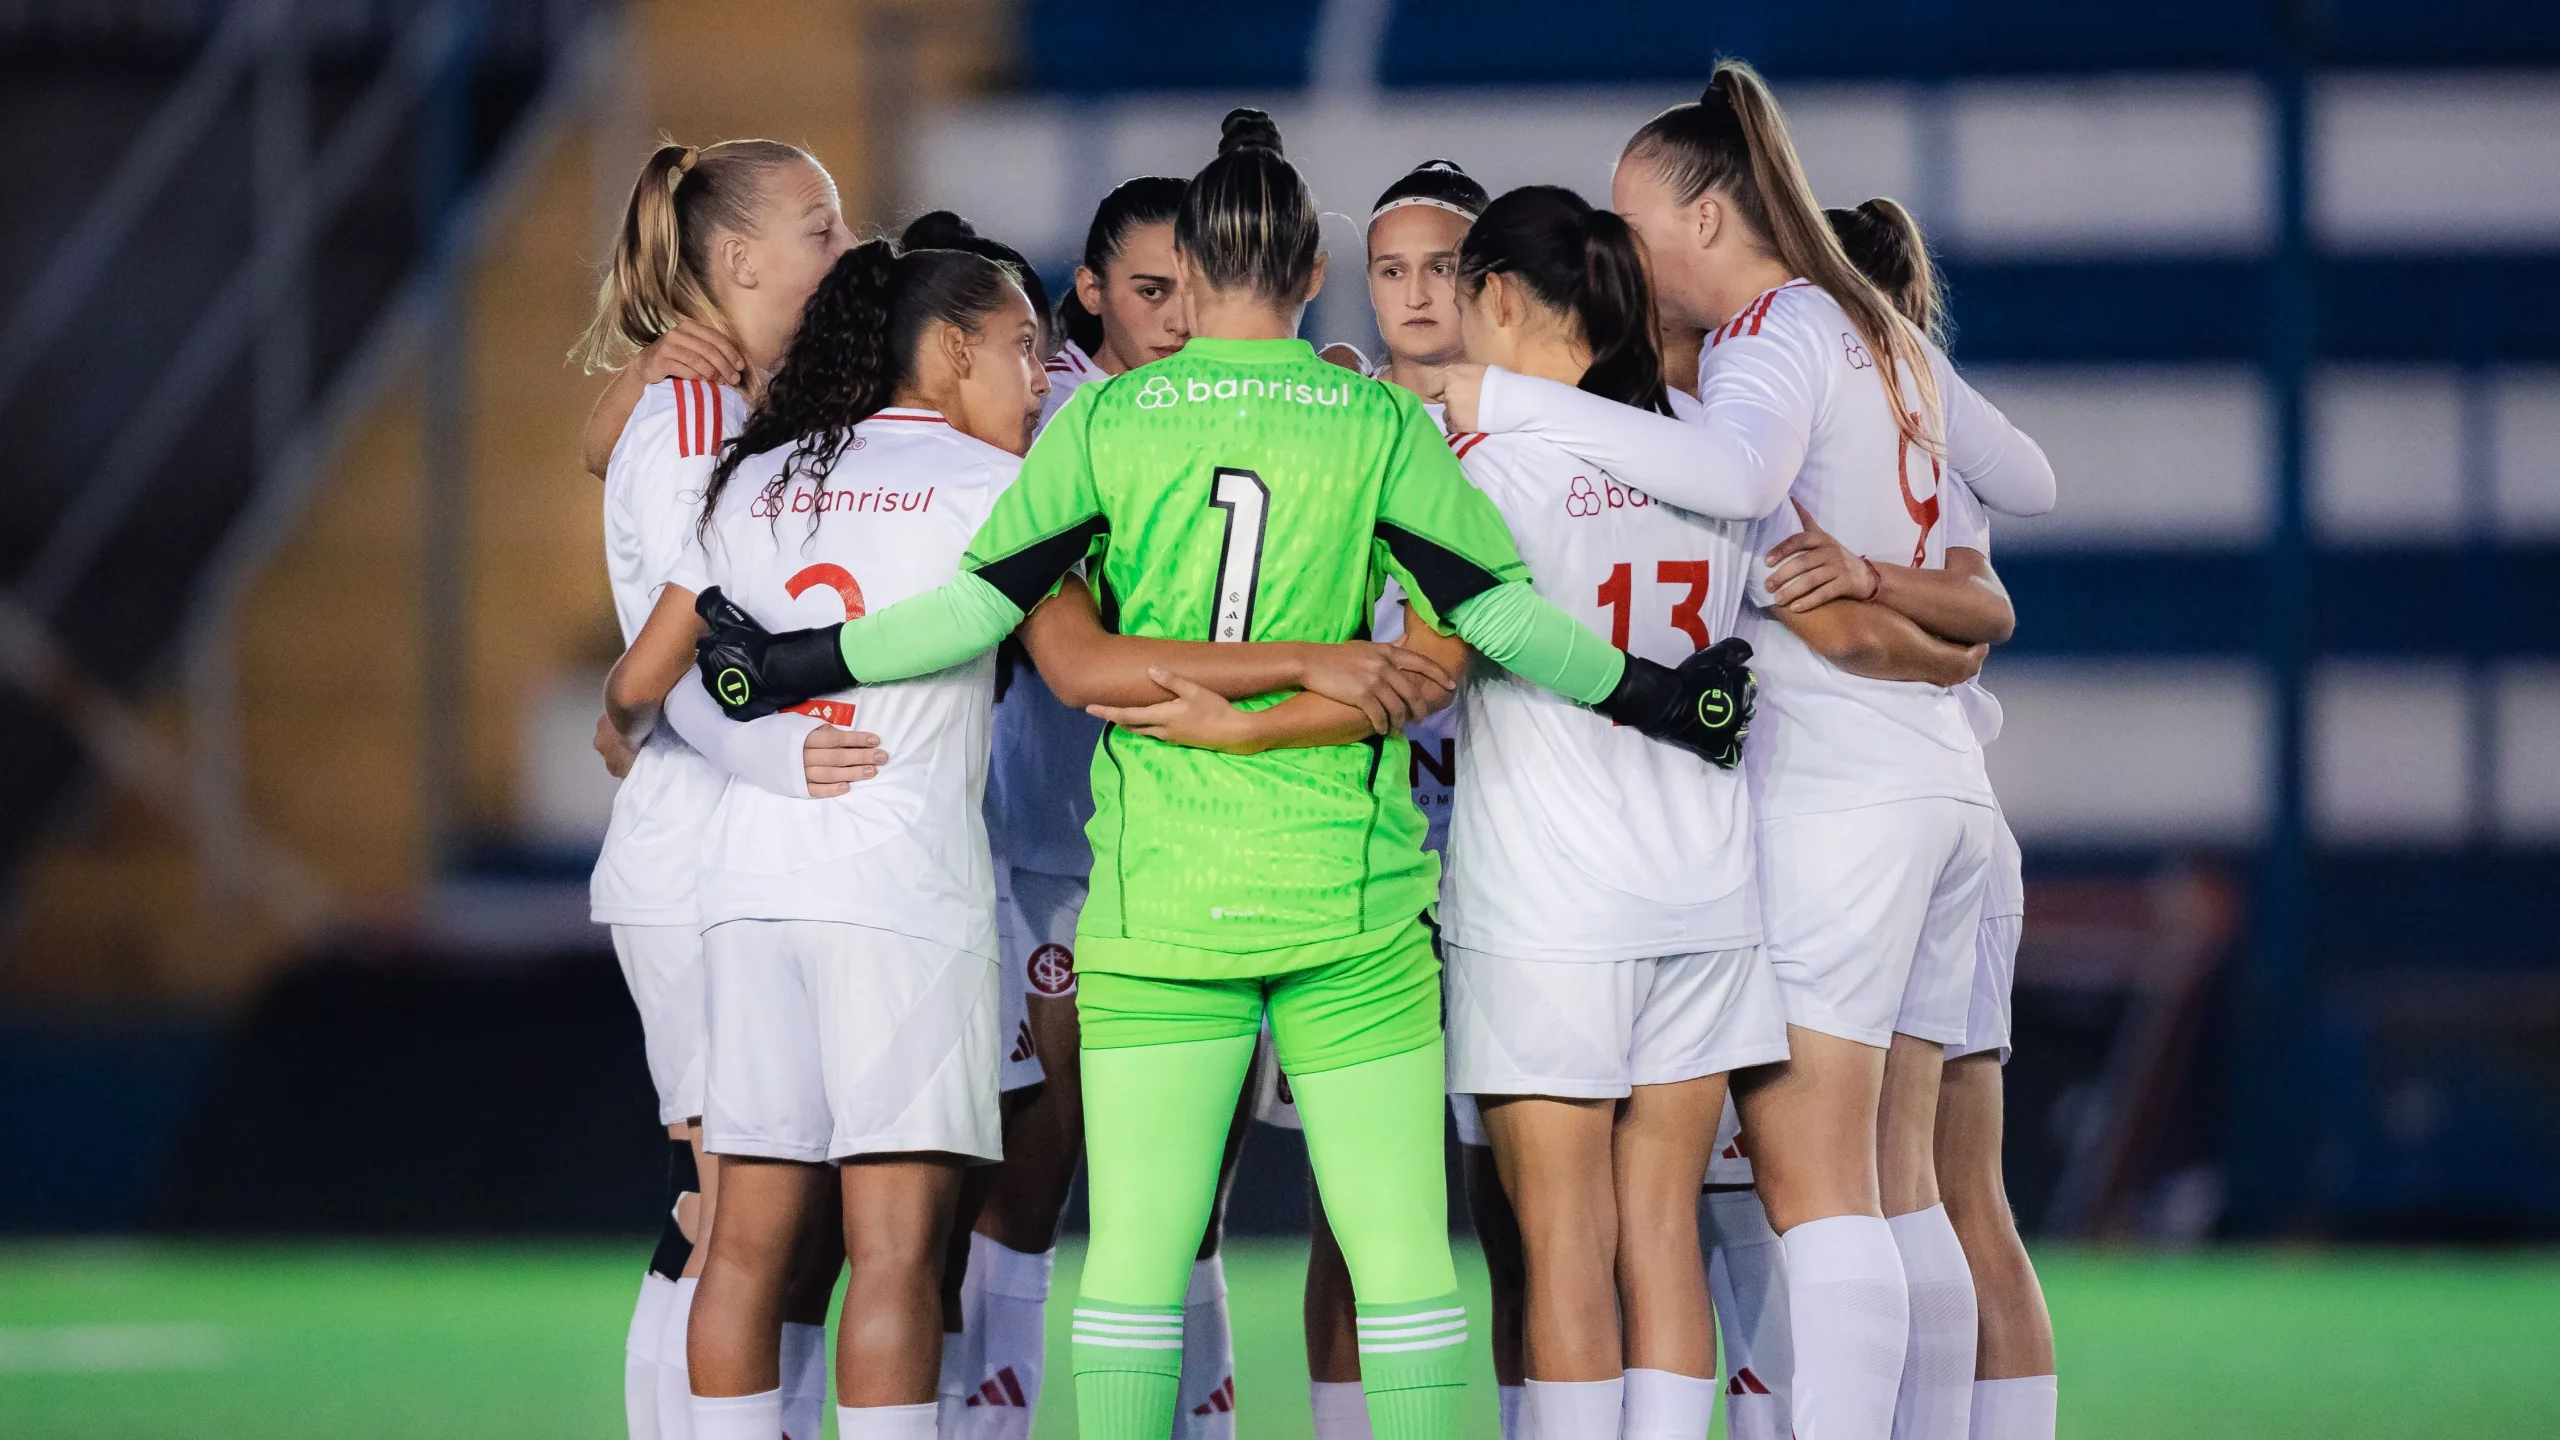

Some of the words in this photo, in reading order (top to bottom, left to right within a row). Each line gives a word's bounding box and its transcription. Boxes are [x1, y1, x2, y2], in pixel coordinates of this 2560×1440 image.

[1187, 377, 1349, 407] banrisul
[791, 486, 935, 513] banrisul
[1208, 466, 1271, 642] 1
[1597, 560, 1710, 727] 13
